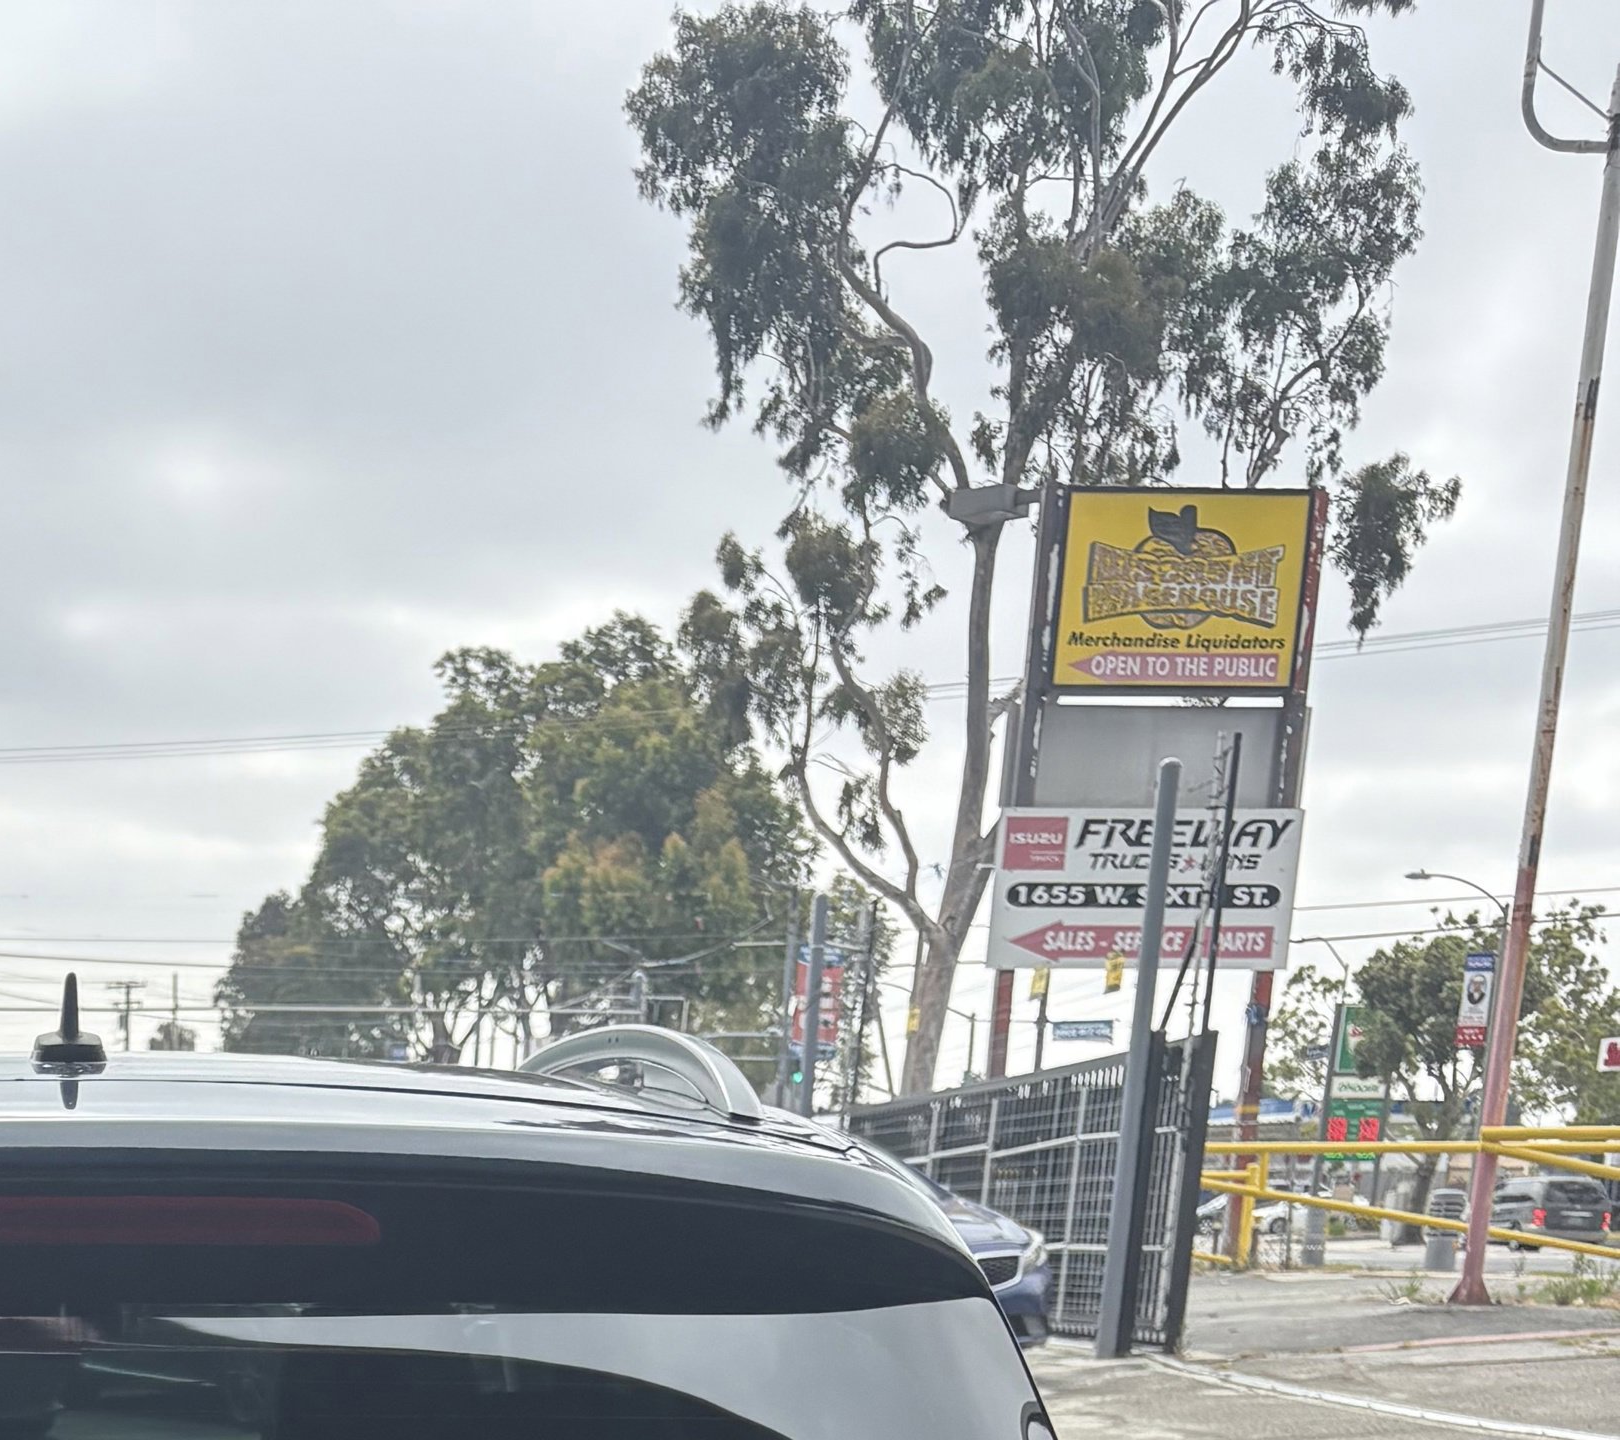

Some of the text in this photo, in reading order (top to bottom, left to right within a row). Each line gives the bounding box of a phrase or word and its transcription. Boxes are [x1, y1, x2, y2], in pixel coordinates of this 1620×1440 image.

[1067, 631, 1286, 652] Merchandise Liquidators
[1090, 655, 1276, 679] OPEN TO THE PUBLIC
[1009, 832, 1063, 845] ISUZU
[1089, 852, 1182, 870] TRUCS
[1015, 885, 1086, 905] 1655
[1093, 886, 1129, 906] W.
[1232, 887, 1270, 907] ST.
[1042, 930, 1096, 951] SALES
